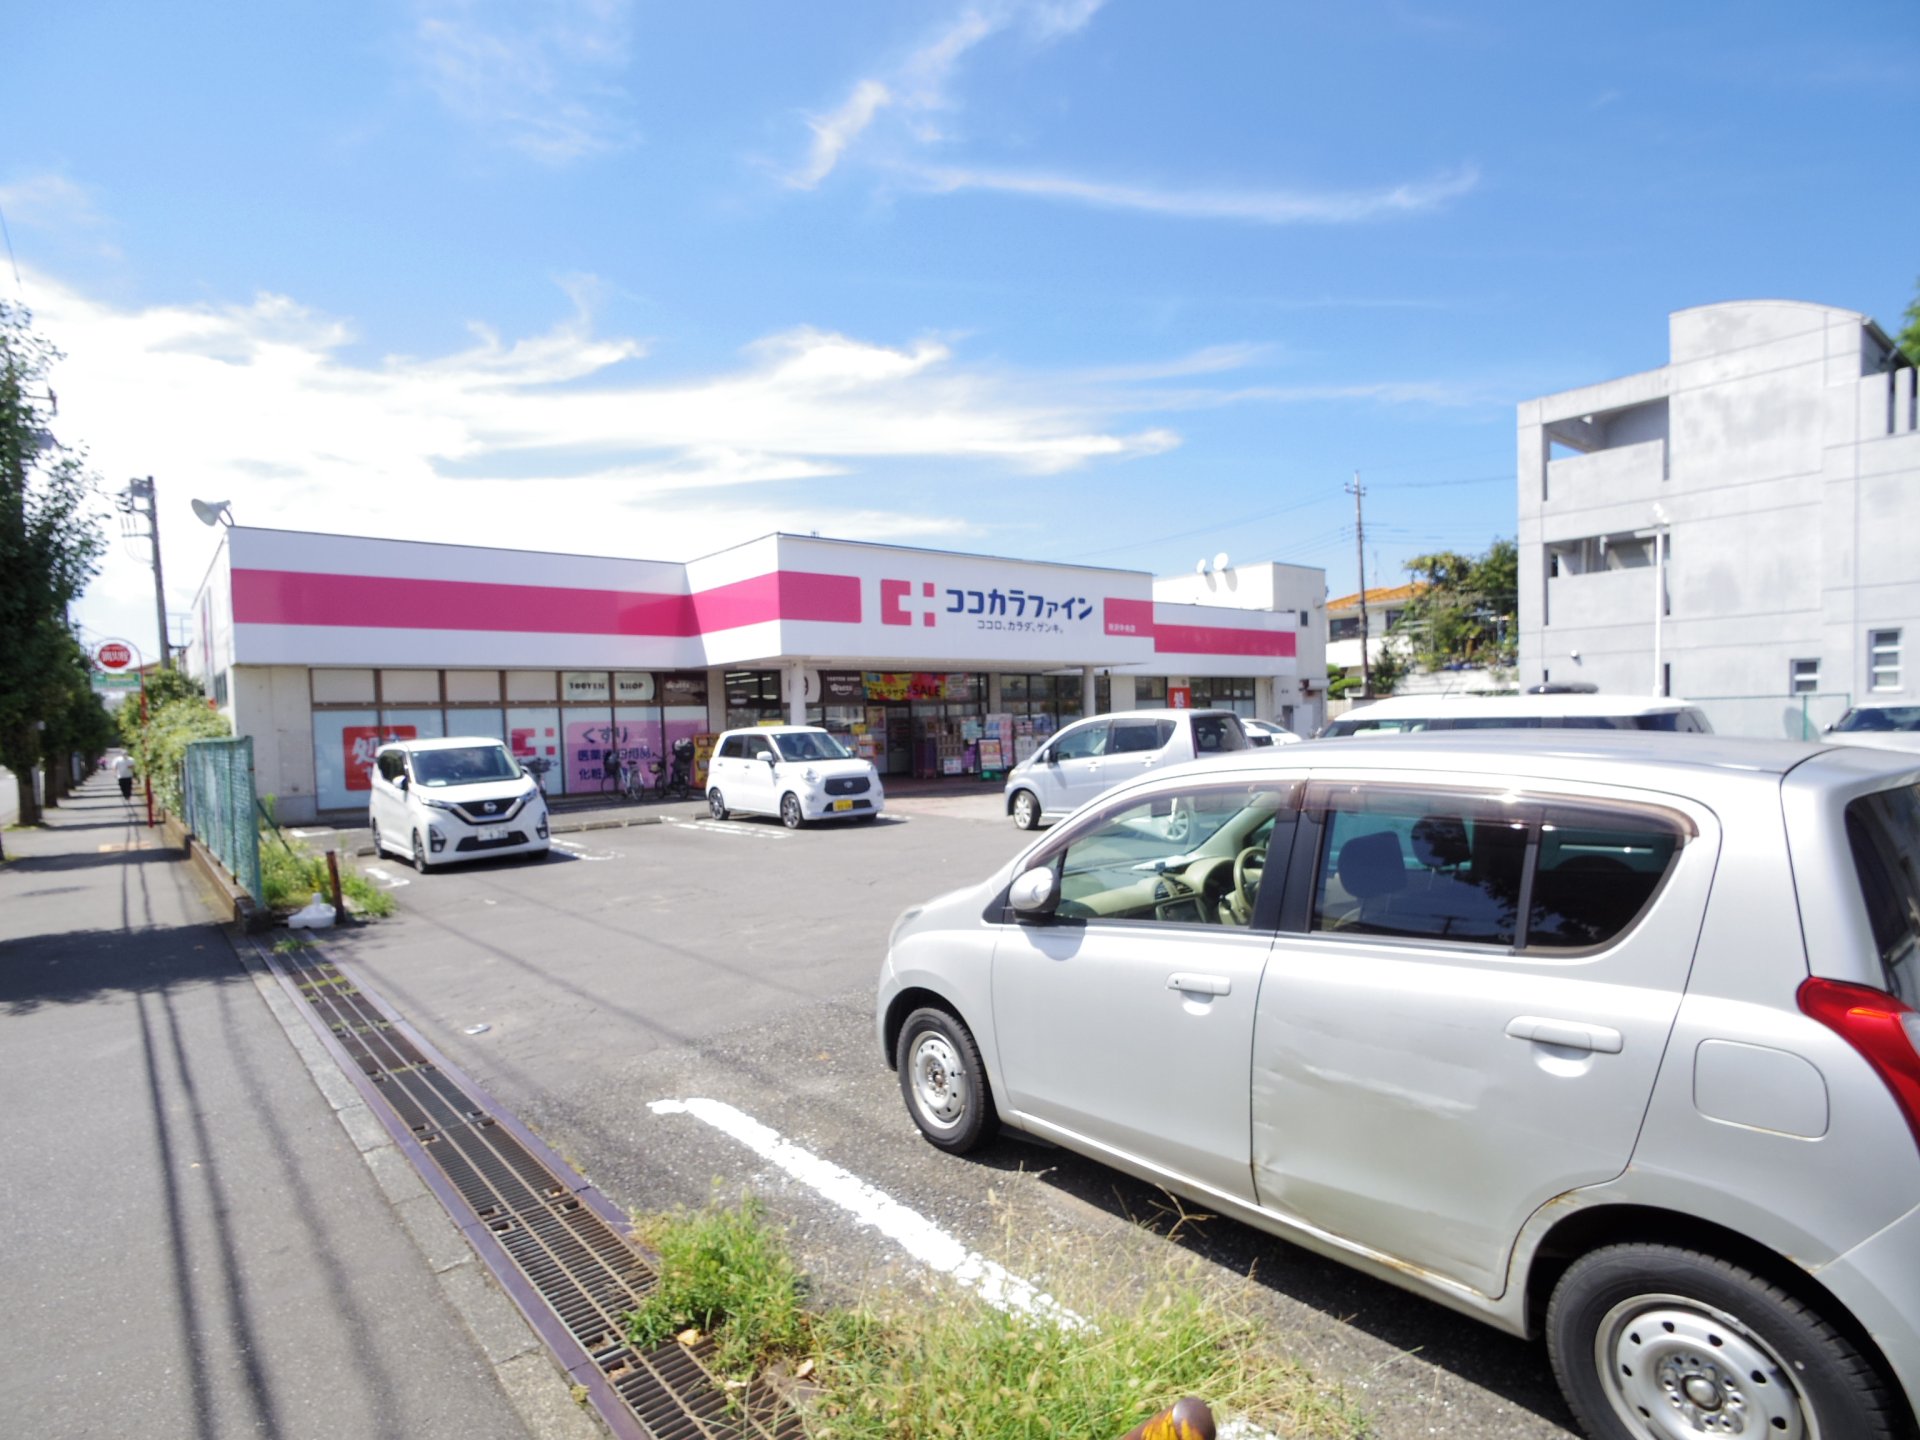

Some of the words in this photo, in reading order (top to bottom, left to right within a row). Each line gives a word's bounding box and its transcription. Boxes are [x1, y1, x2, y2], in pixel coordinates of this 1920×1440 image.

[946, 588, 1093, 620] ココカラファイン
[620, 682, 644, 690] SHOP
[912, 684, 941, 697] SALE
[582, 727, 629, 744] くすり
